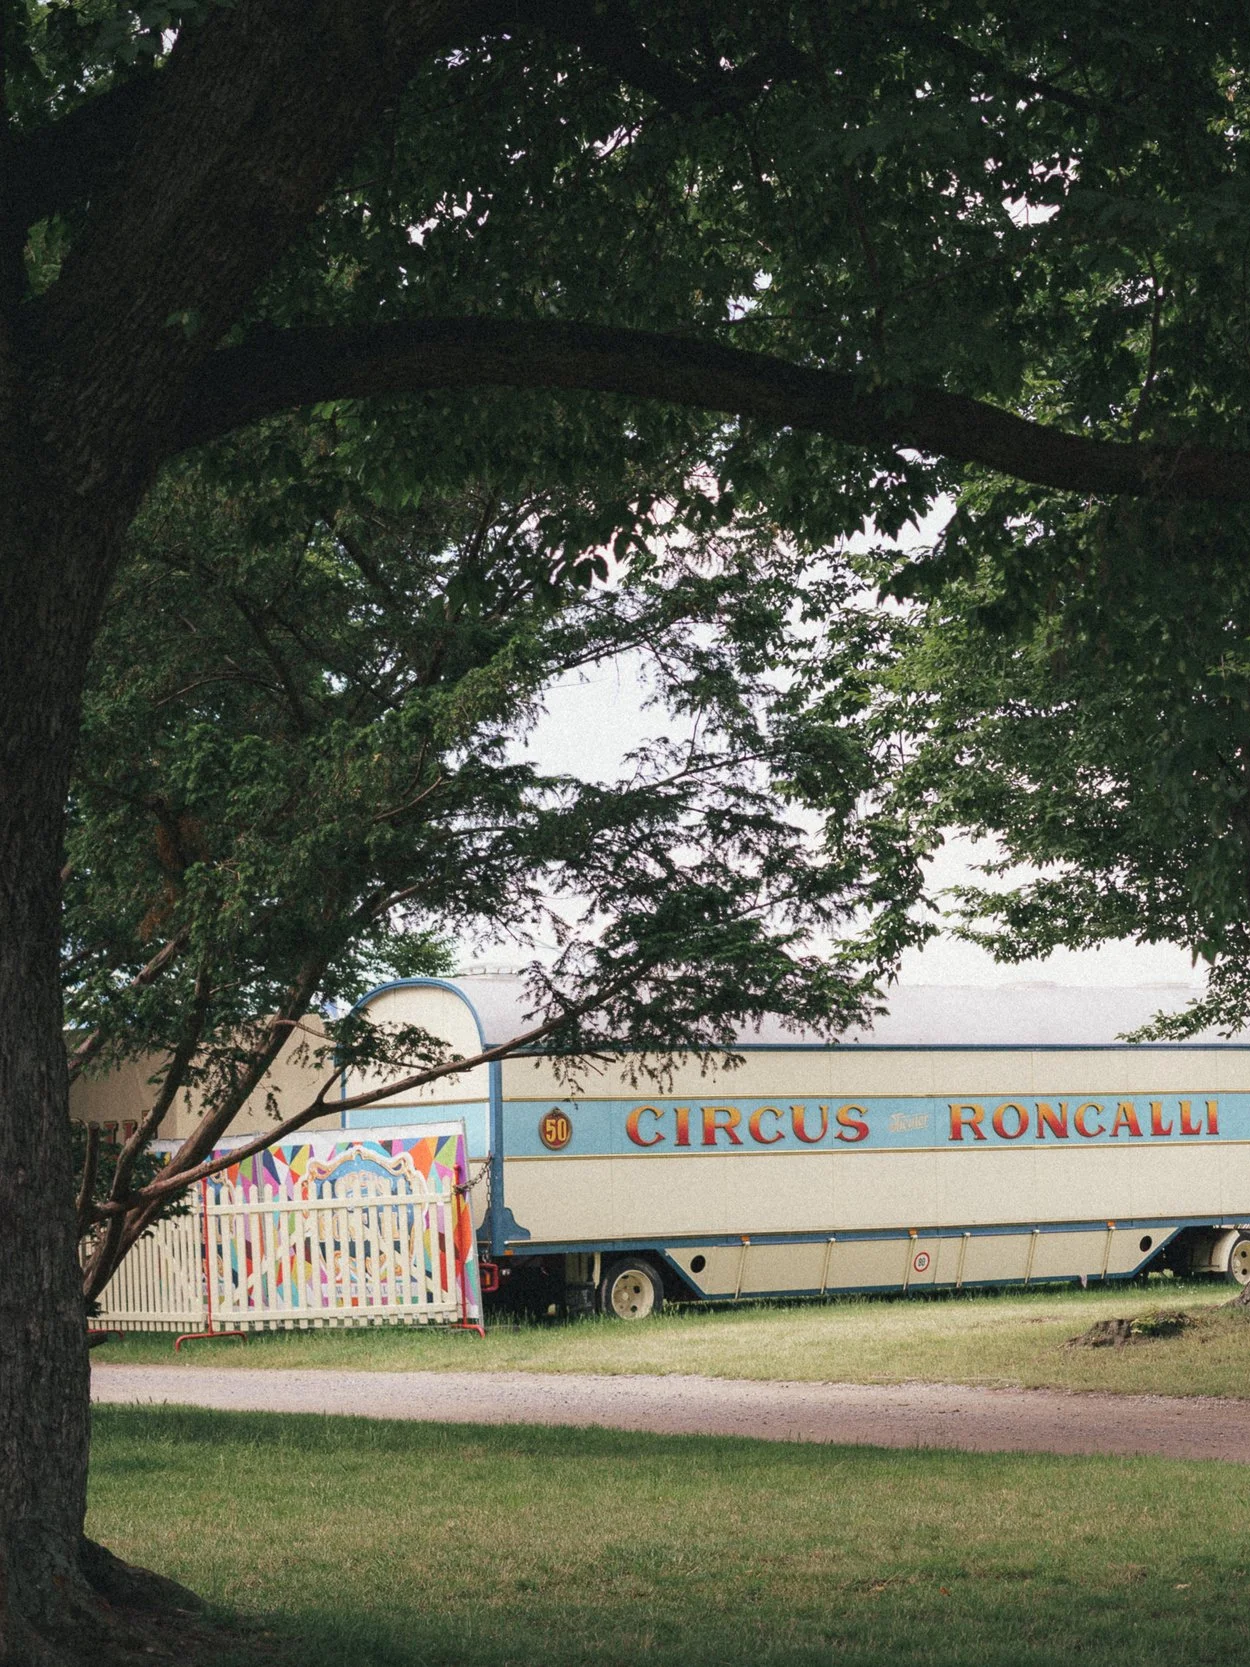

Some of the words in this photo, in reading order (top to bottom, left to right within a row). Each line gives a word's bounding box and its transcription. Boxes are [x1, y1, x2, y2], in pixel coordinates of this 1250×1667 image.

[545, 1118, 567, 1142] 50
[625, 1104, 869, 1147] CIRCUS
[948, 1100, 1219, 1141] RONCALLI
